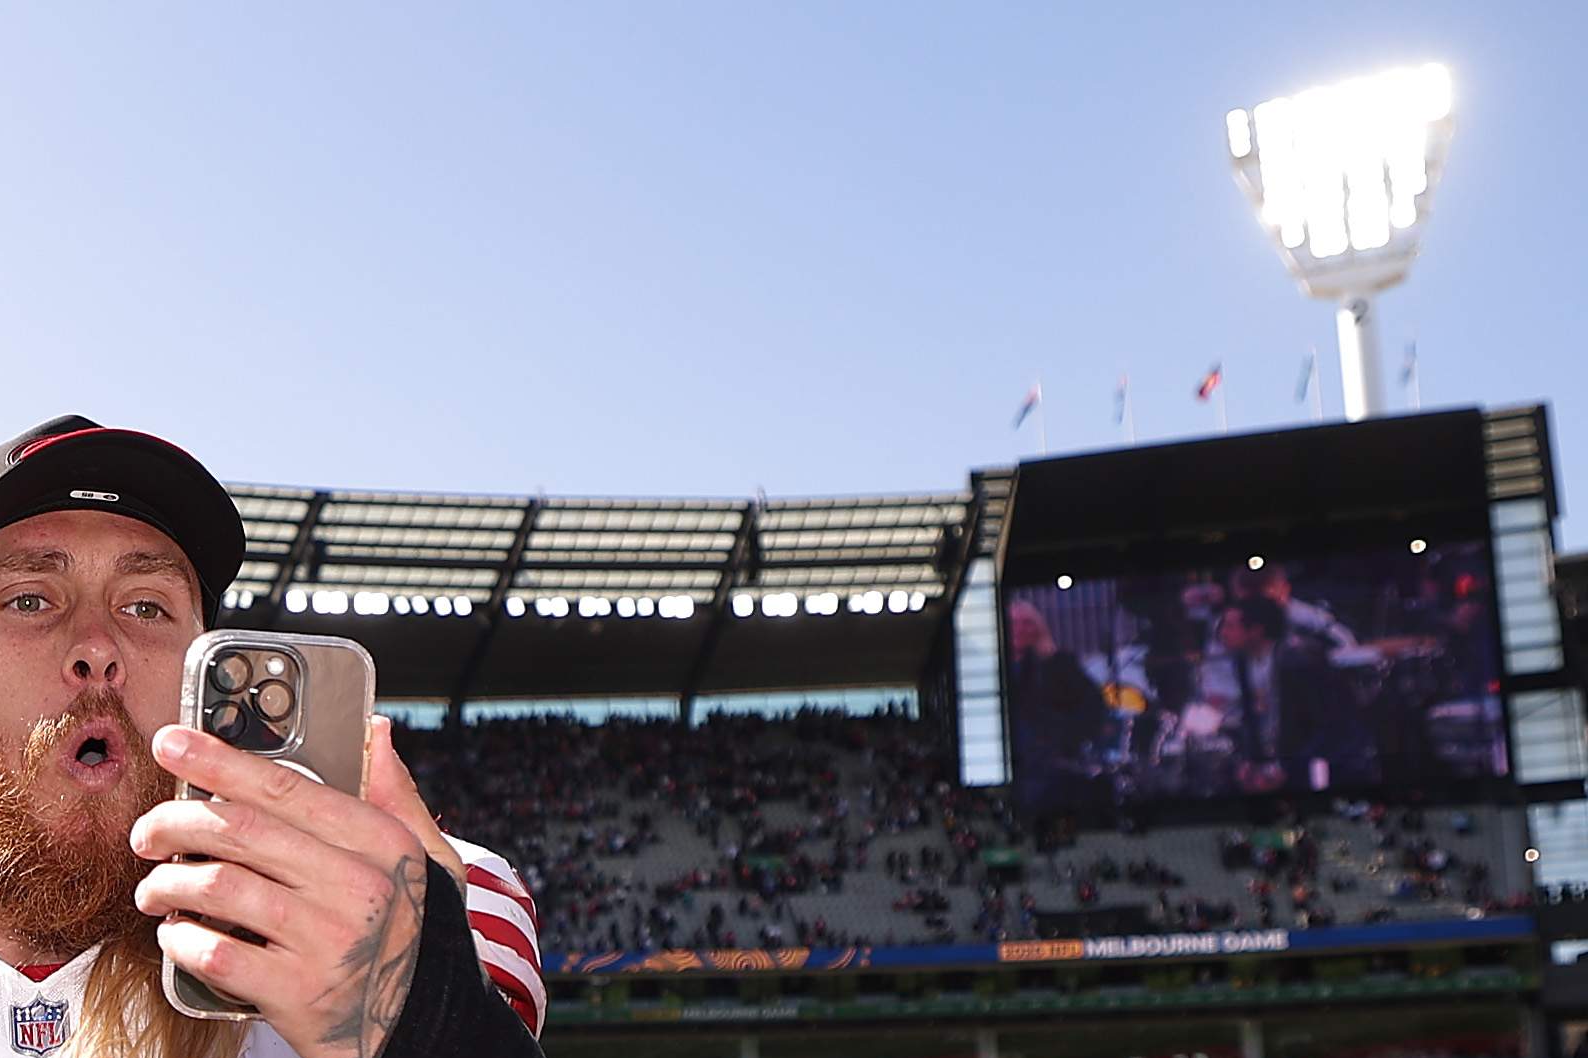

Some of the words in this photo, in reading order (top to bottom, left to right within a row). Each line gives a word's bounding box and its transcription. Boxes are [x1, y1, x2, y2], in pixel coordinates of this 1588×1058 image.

[1085, 932, 1218, 957] MELBOURNE
[1220, 929, 1289, 951] GAME
[19, 1022, 61, 1049] NFL
